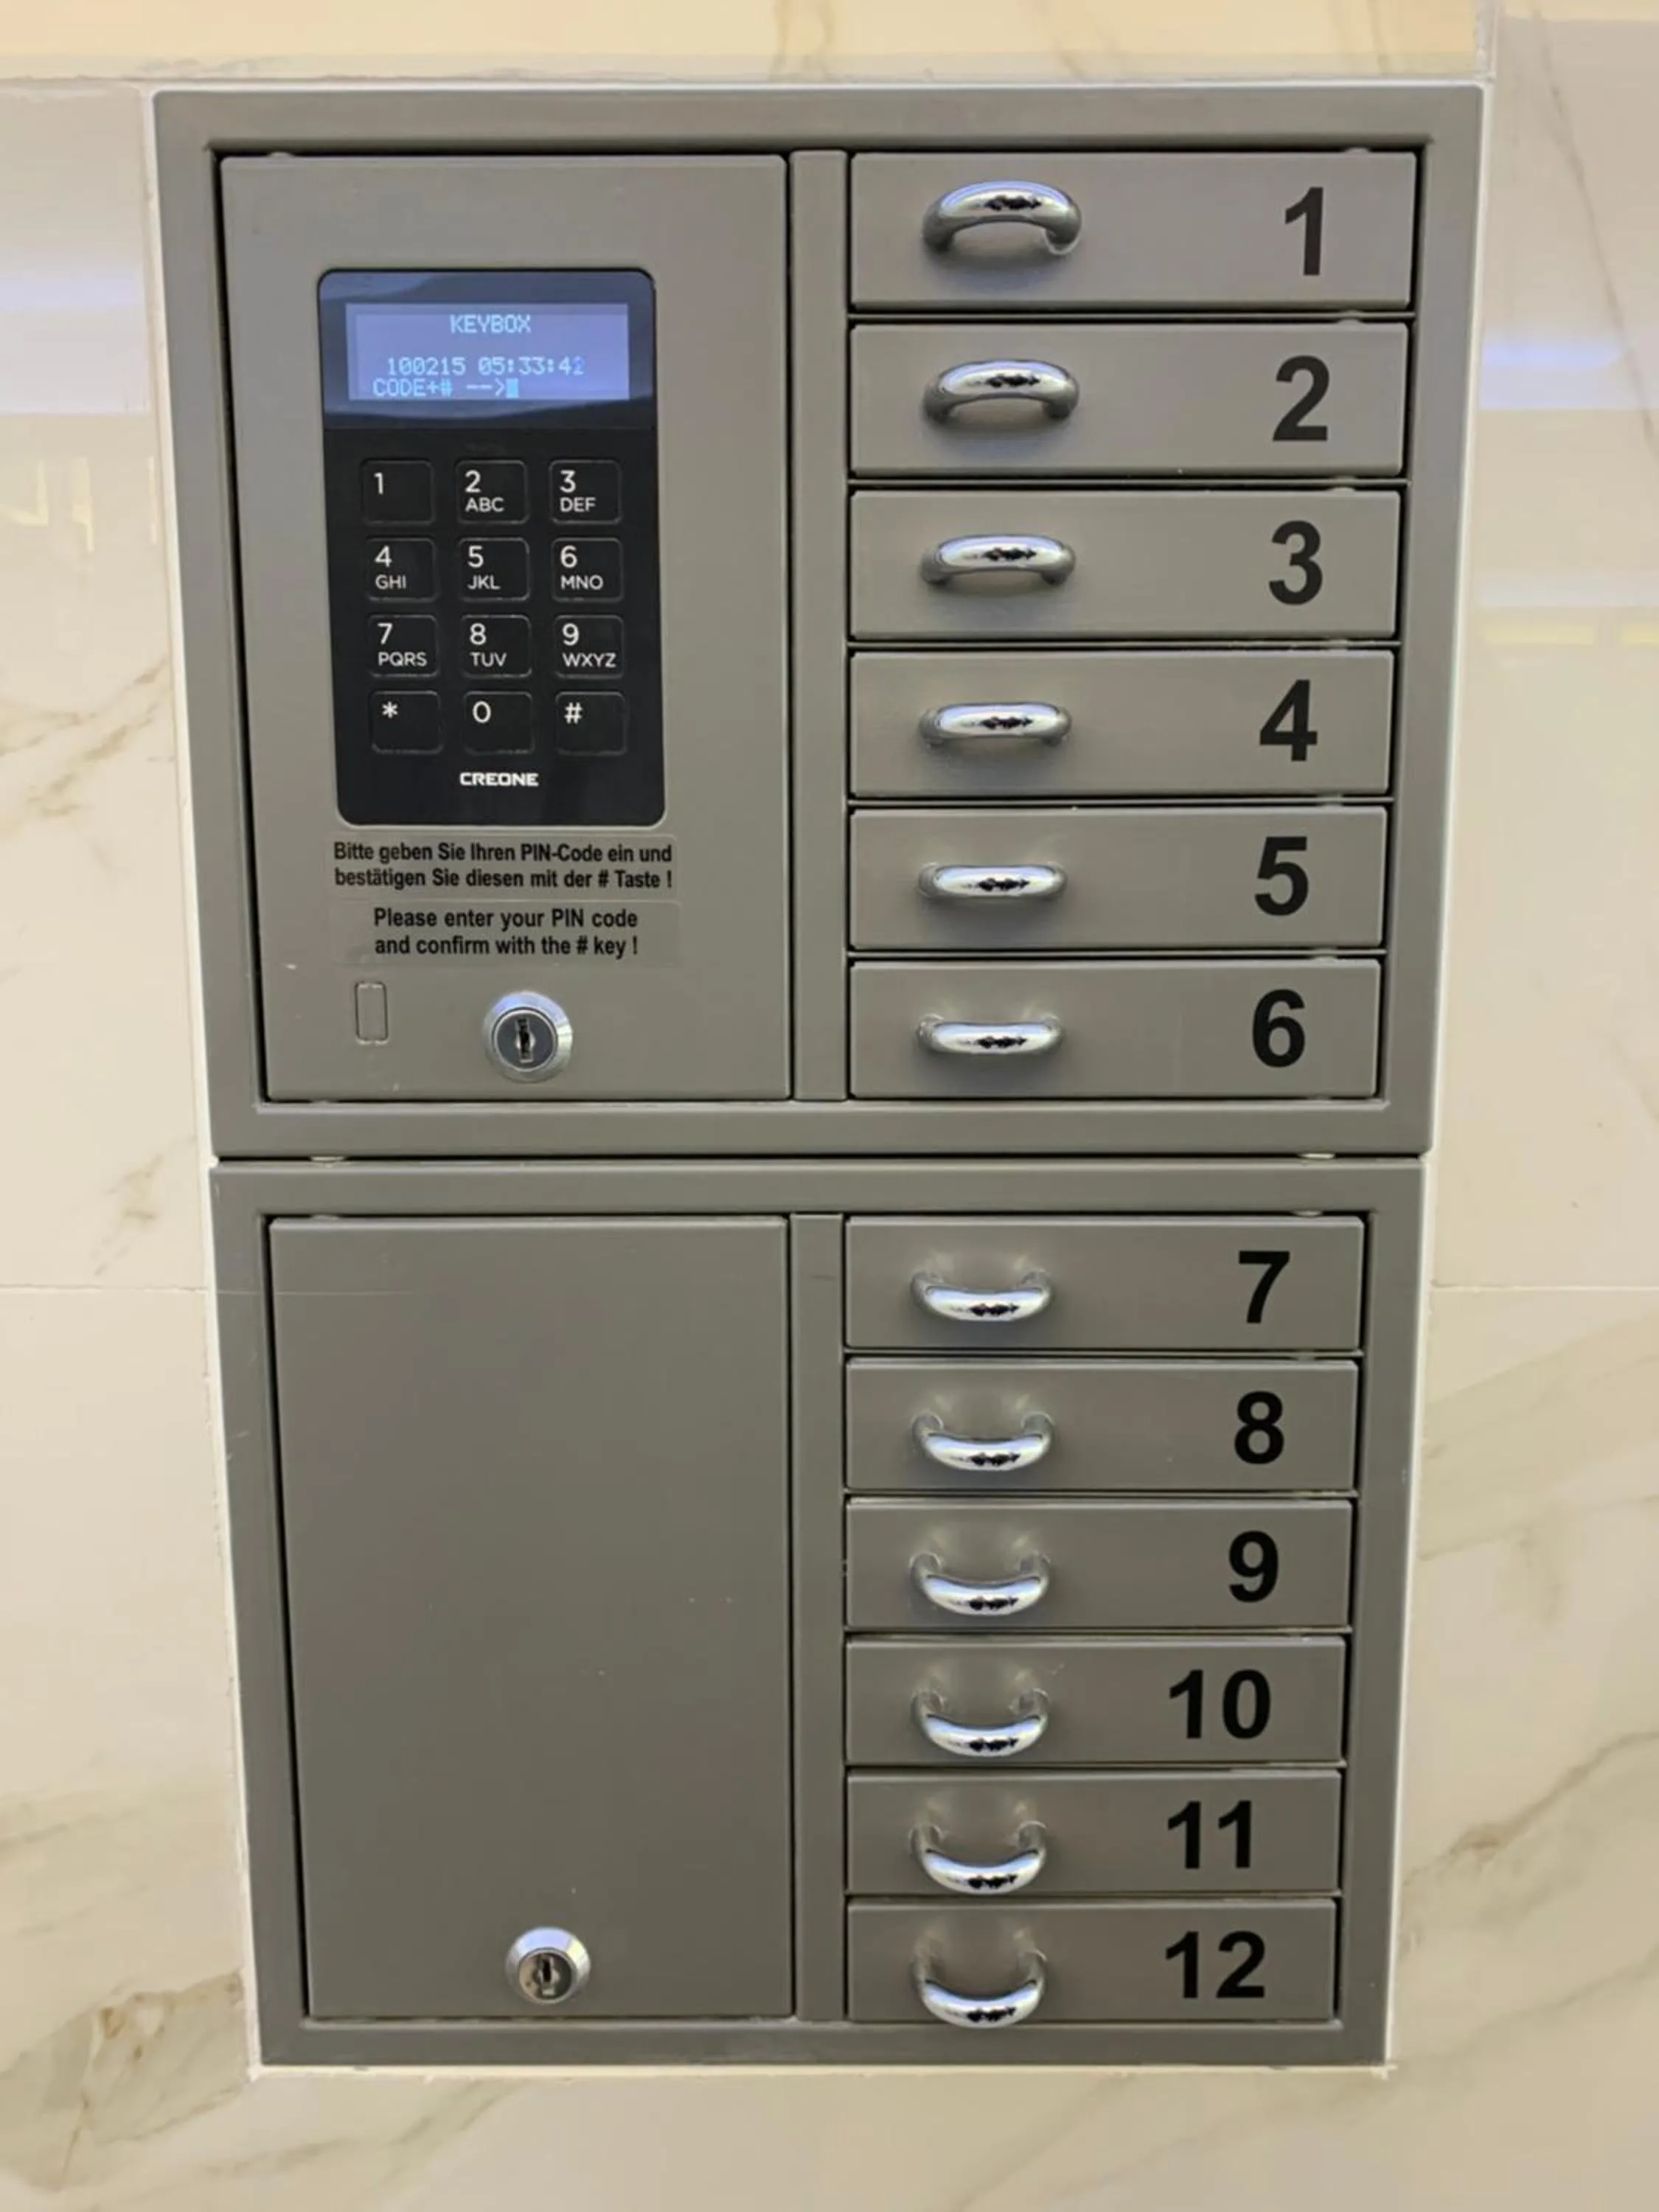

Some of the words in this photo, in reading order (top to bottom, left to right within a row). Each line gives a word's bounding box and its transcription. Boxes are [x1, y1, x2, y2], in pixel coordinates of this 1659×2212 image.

[1285, 187, 1323, 275] 1
[449, 314, 531, 334] KEYBOX
[386, 357, 467, 376] 100215
[372, 378, 453, 397] CODE+#
[1273, 356, 1329, 441] 2
[374, 472, 383, 495] 1
[465, 470, 481, 493] 2
[560, 470, 576, 493] 3
[465, 496, 504, 512] ABC
[560, 496, 596, 512] DEF
[375, 546, 392, 567] 4
[468, 545, 484, 568] 5
[560, 545, 578, 568] 6
[1269, 521, 1322, 605] 3
[375, 574, 406, 590] GHI
[467, 574, 501, 590] JKL
[560, 574, 604, 591] MNO
[378, 622, 393, 644] 7
[470, 622, 487, 646] 8
[562, 622, 580, 646] 9
[378, 651, 428, 667] PQRS
[470, 651, 507, 667] TUV
[562, 652, 616, 668] WXYZ
[472, 700, 492, 723] 0
[564, 702, 582, 724] #
[1260, 680, 1317, 761] 4
[459, 772, 539, 787] CREONE
[333, 841, 375, 860] Bitte
[378, 842, 434, 865] geben
[437, 841, 466, 861] Sie
[470, 842, 516, 861] Ihren
[521, 843, 603, 862] PIN-Code
[607, 844, 635, 863] ein
[639, 844, 672, 863] und
[334, 867, 426, 891] bestätigen
[431, 867, 460, 887] Sie
[465, 868, 524, 888] diesen
[530, 869, 558, 888] mit
[563, 869, 593, 888] der
[613, 869, 661, 888] Taste
[1255, 837, 1308, 916] 5
[374, 907, 437, 928] Please
[444, 909, 495, 928] enter
[500, 912, 545, 933] your
[552, 908, 584, 928] PIN
[591, 908, 638, 928] code
[375, 934, 411, 955] and
[415, 934, 490, 955] confirm
[495, 935, 535, 955] with
[540, 936, 571, 955] the
[594, 935, 627, 960] key
[1253, 990, 1304, 1067] 6
[1239, 1251, 1290, 1324] 7
[1235, 1391, 1284, 1464] 8
[1229, 1531, 1278, 1602] 9
[1170, 1669, 1270, 1739] 10
[1168, 1801, 1251, 1868] 11
[1166, 1931, 1265, 1998] 12
